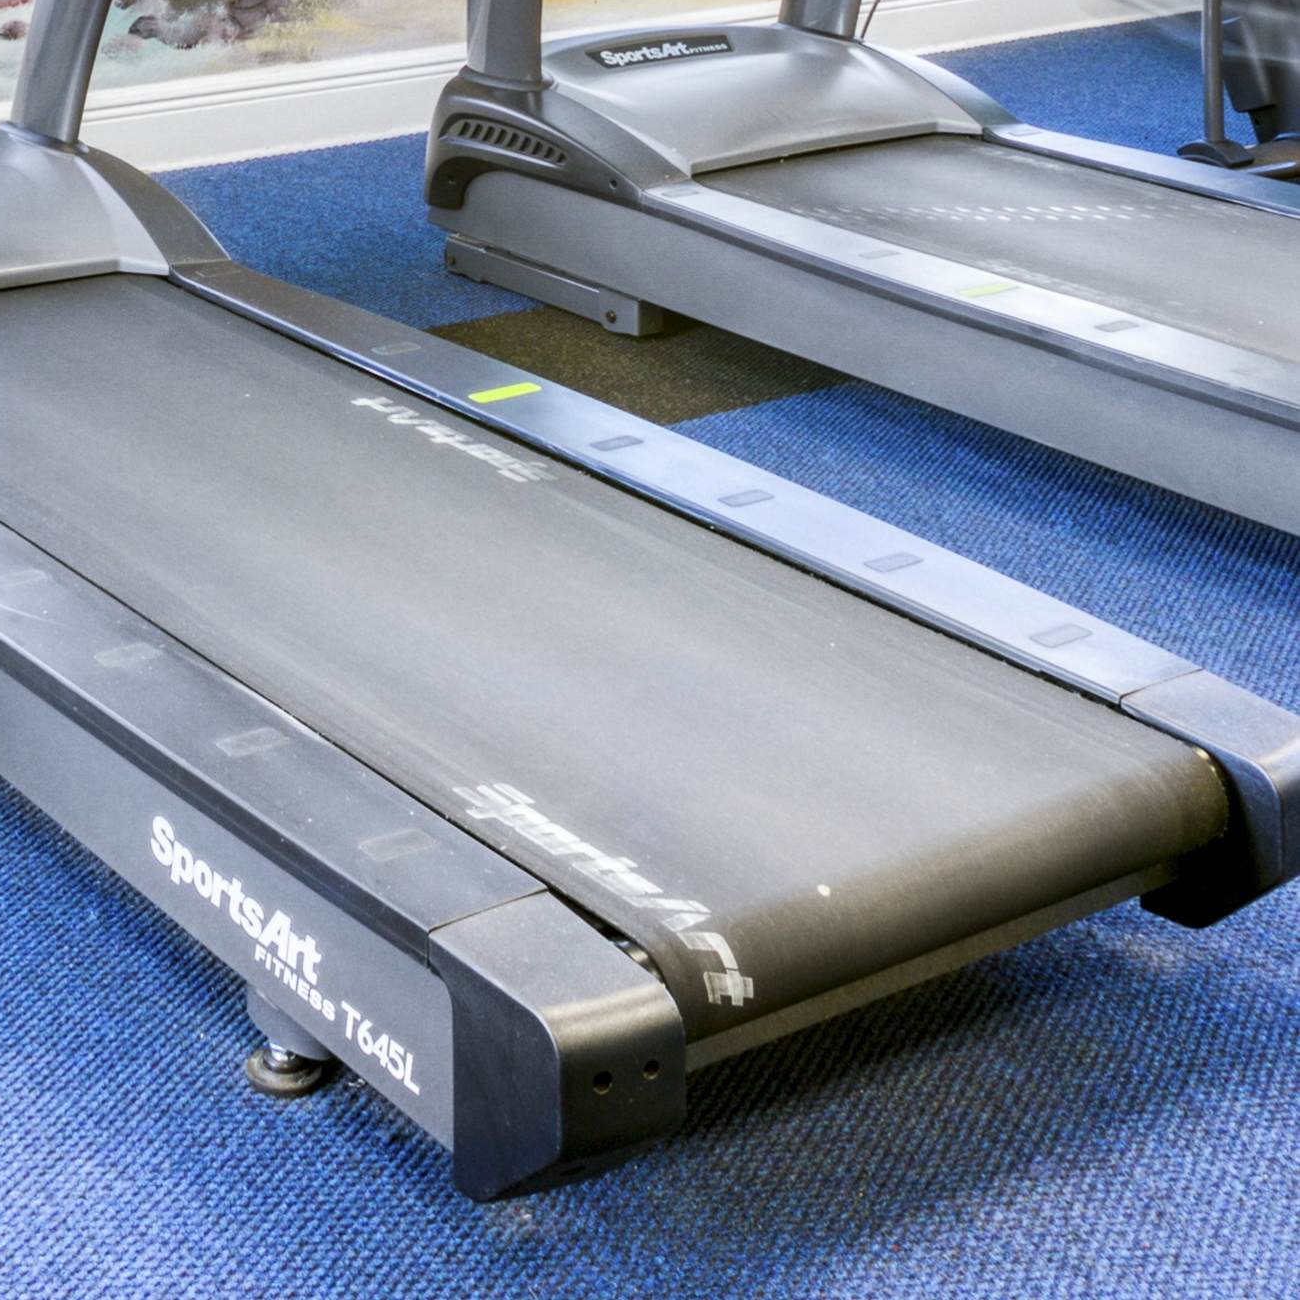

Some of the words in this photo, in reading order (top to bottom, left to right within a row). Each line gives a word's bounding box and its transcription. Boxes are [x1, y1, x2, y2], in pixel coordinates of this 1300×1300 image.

[600, 41, 690, 67] SportsArt
[690, 43, 728, 55] FITNESS
[150, 814, 322, 984] SportsArt
[254, 947, 336, 1022] FITNESS
[340, 999, 421, 1095] T645L
